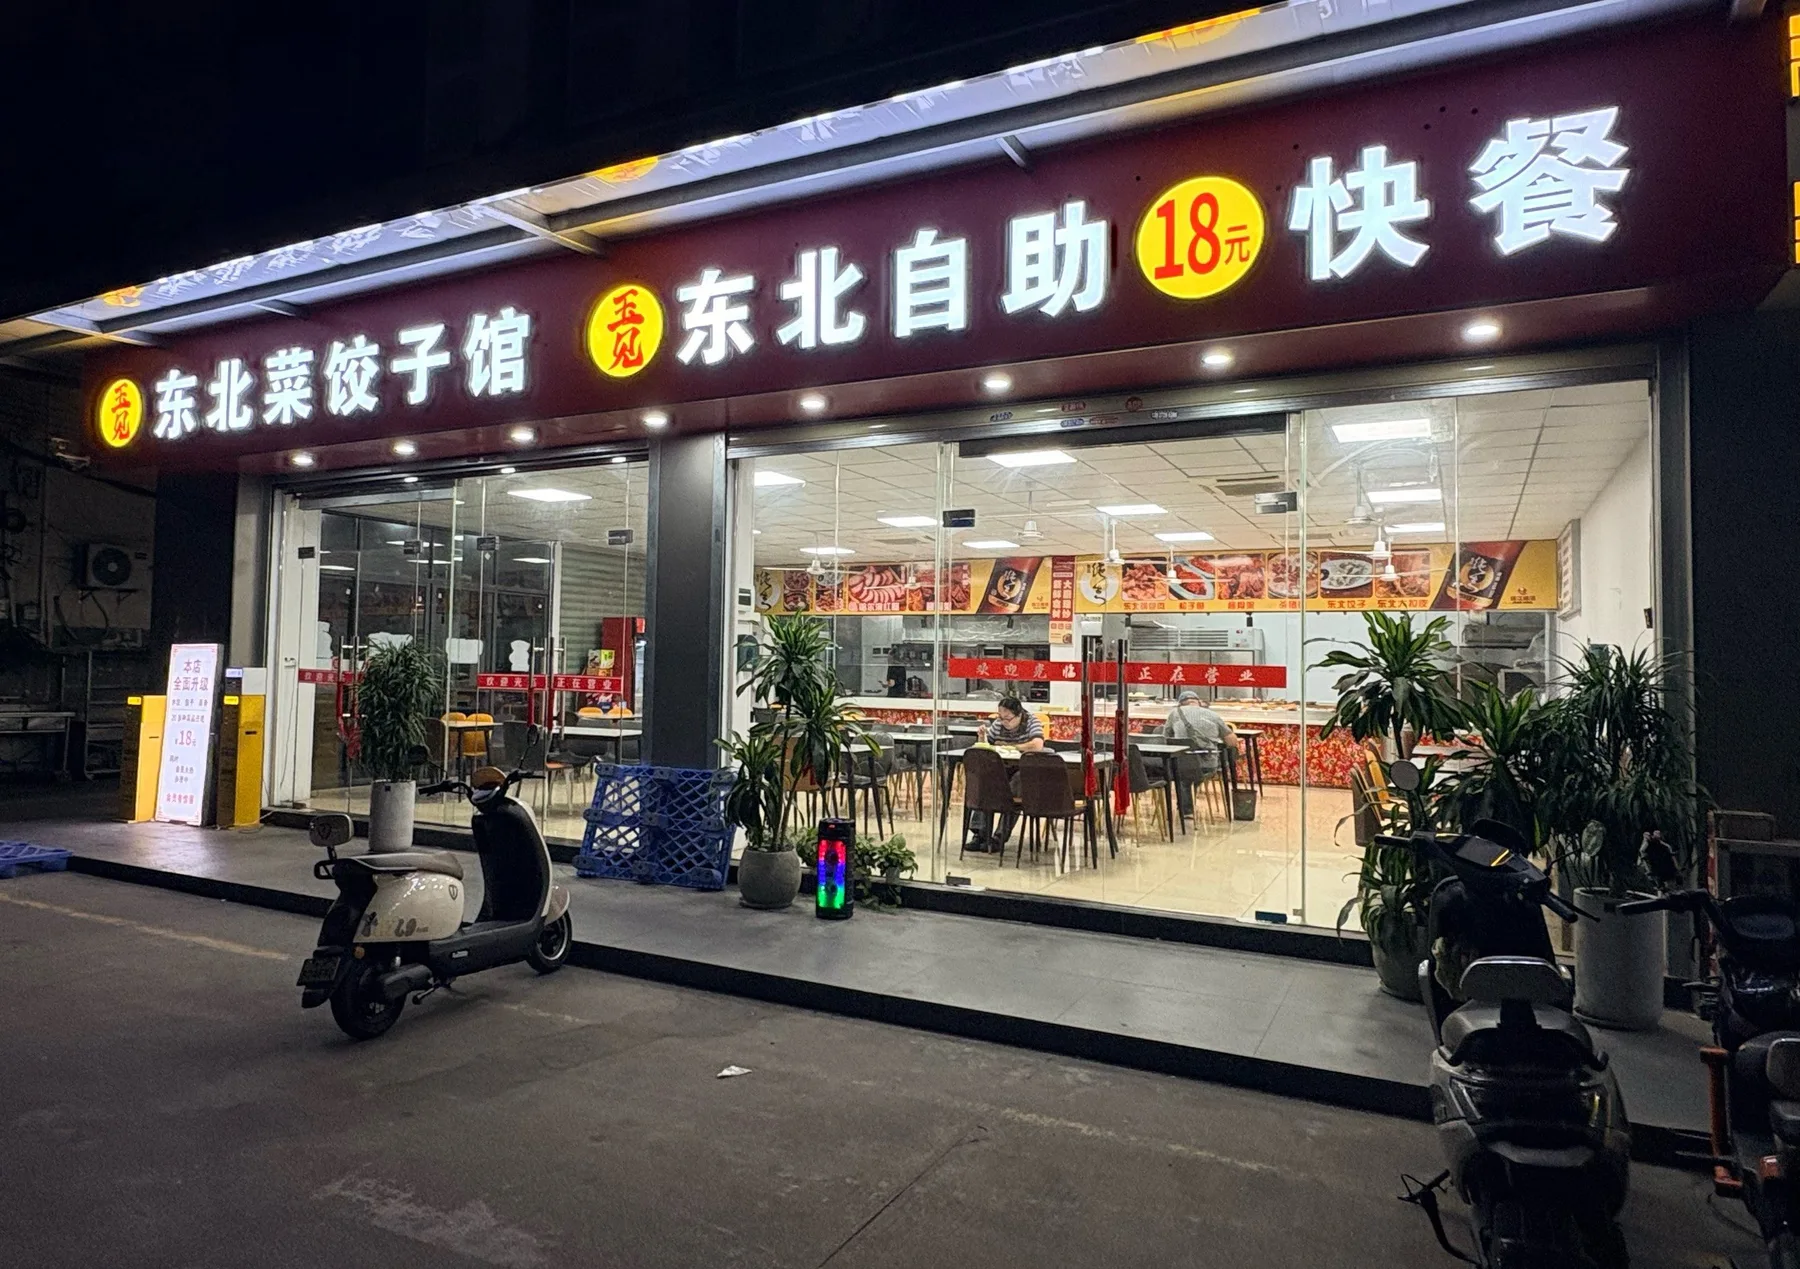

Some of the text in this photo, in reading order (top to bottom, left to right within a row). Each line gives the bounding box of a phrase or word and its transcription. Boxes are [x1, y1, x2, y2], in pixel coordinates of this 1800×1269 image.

[677, 200, 1108, 367] 东北自助
[1154, 191, 1251, 281] 18元
[1289, 106, 1630, 281] 快餐
[153, 306, 531, 440] 东北菜饺子馆
[183, 659, 202, 674] 本店
[976, 662, 1256, 684] 欢迎光临 正在营业
[173, 677, 209, 692] 全面升级
[557, 677, 612, 690] 正在营业
